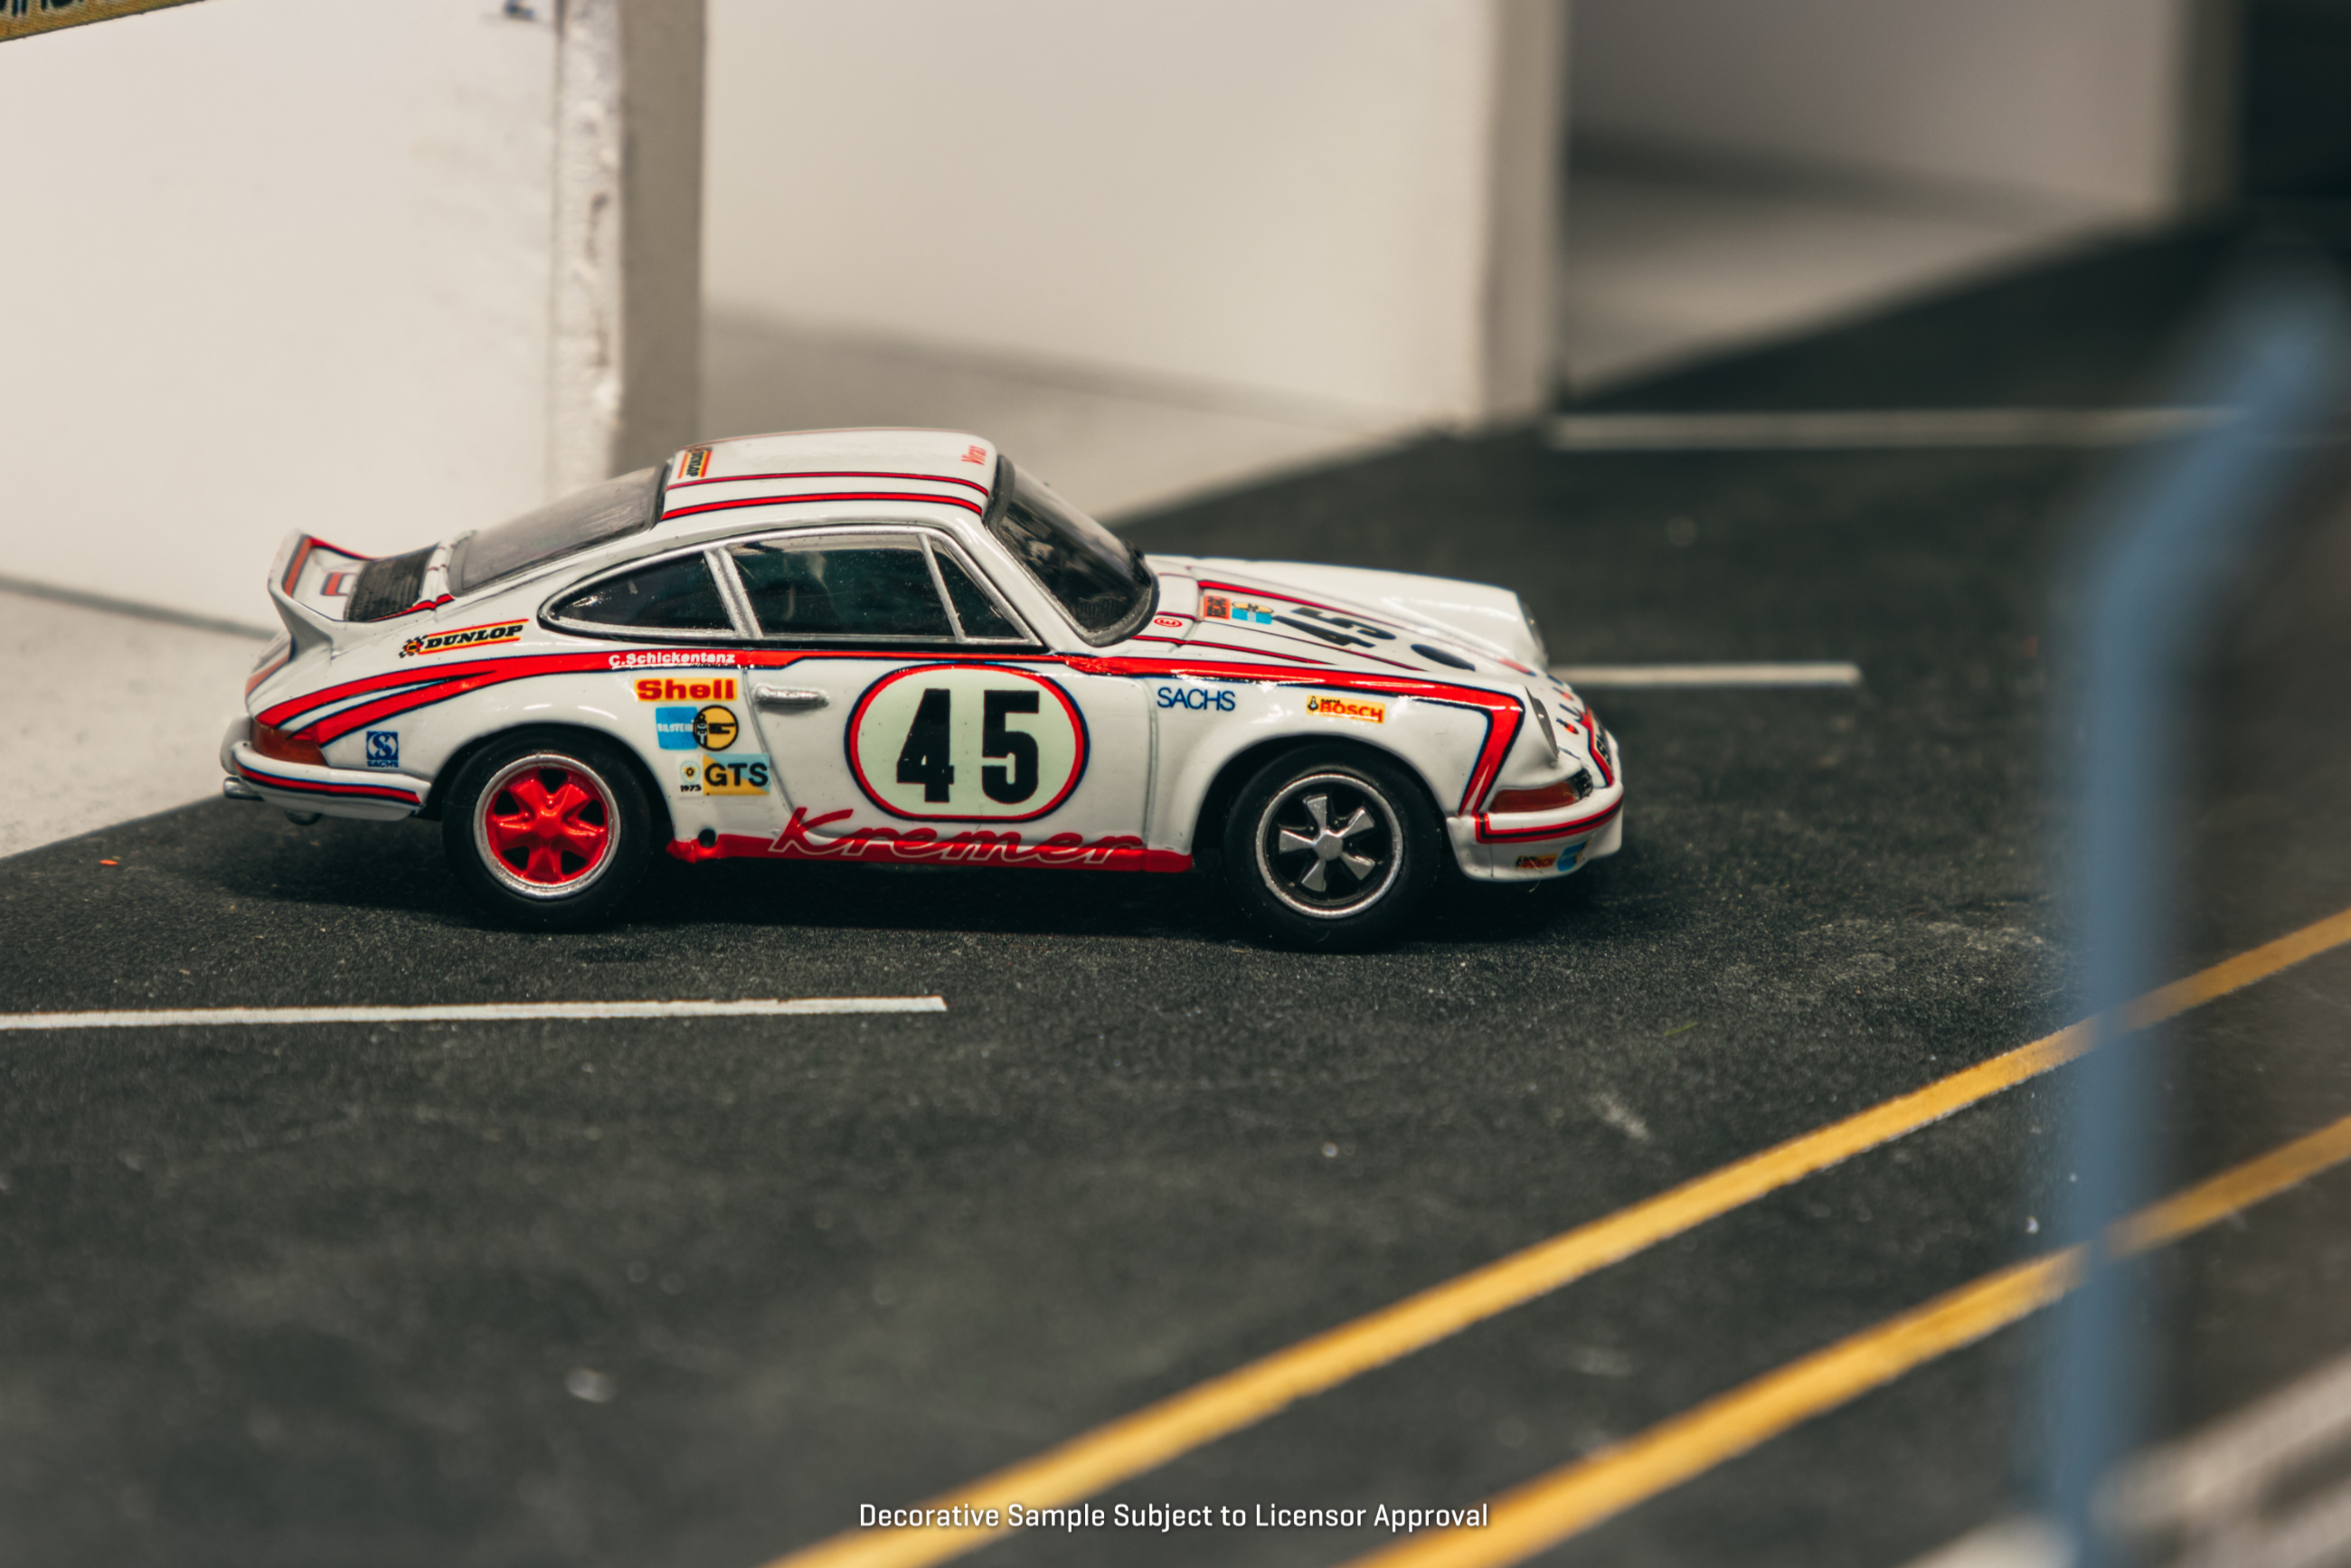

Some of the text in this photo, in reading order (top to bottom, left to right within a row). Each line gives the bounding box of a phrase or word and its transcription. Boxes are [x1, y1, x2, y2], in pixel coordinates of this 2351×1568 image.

[424, 624, 524, 649] DUNLOP
[637, 679, 734, 700] Shell
[1157, 685, 1236, 712] SACHS
[1320, 702, 1383, 723] BOSCH
[896, 687, 1040, 805] 45
[703, 762, 769, 788] GTS
[768, 807, 1144, 864] Kremer
